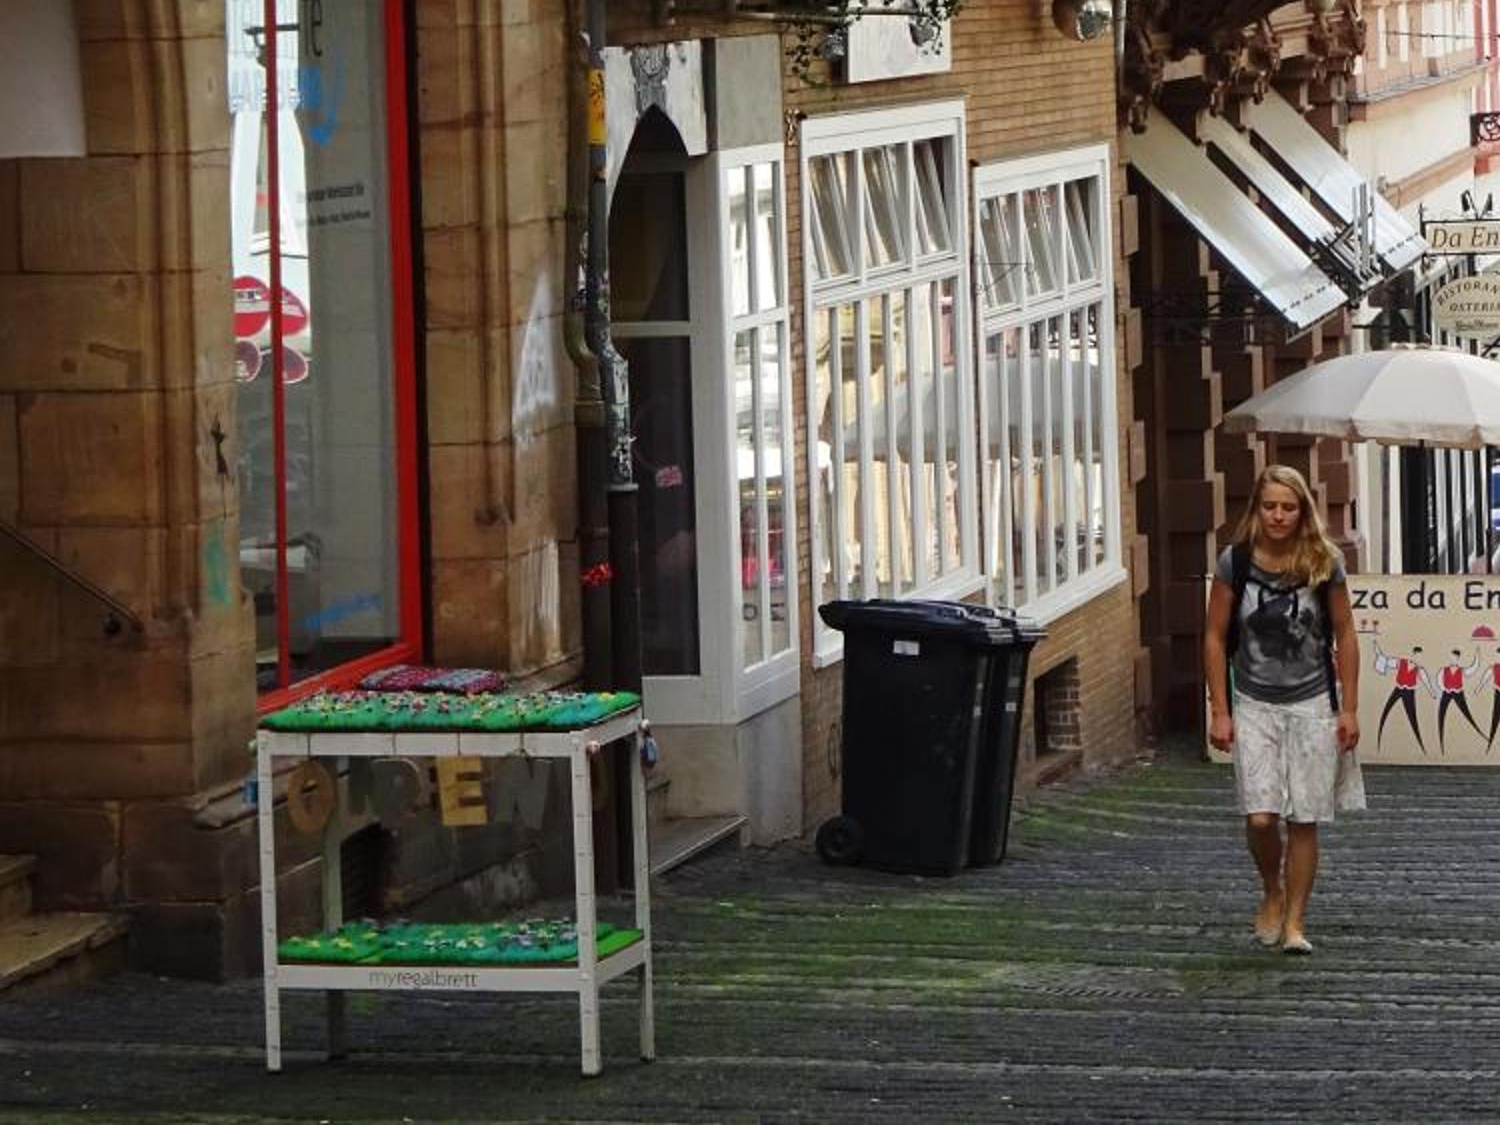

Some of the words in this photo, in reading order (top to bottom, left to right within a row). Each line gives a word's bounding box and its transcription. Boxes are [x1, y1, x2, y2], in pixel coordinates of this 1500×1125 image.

[1432, 228, 1461, 248] Da
[1351, 589, 1388, 609] za
[1406, 580, 1446, 609] da
